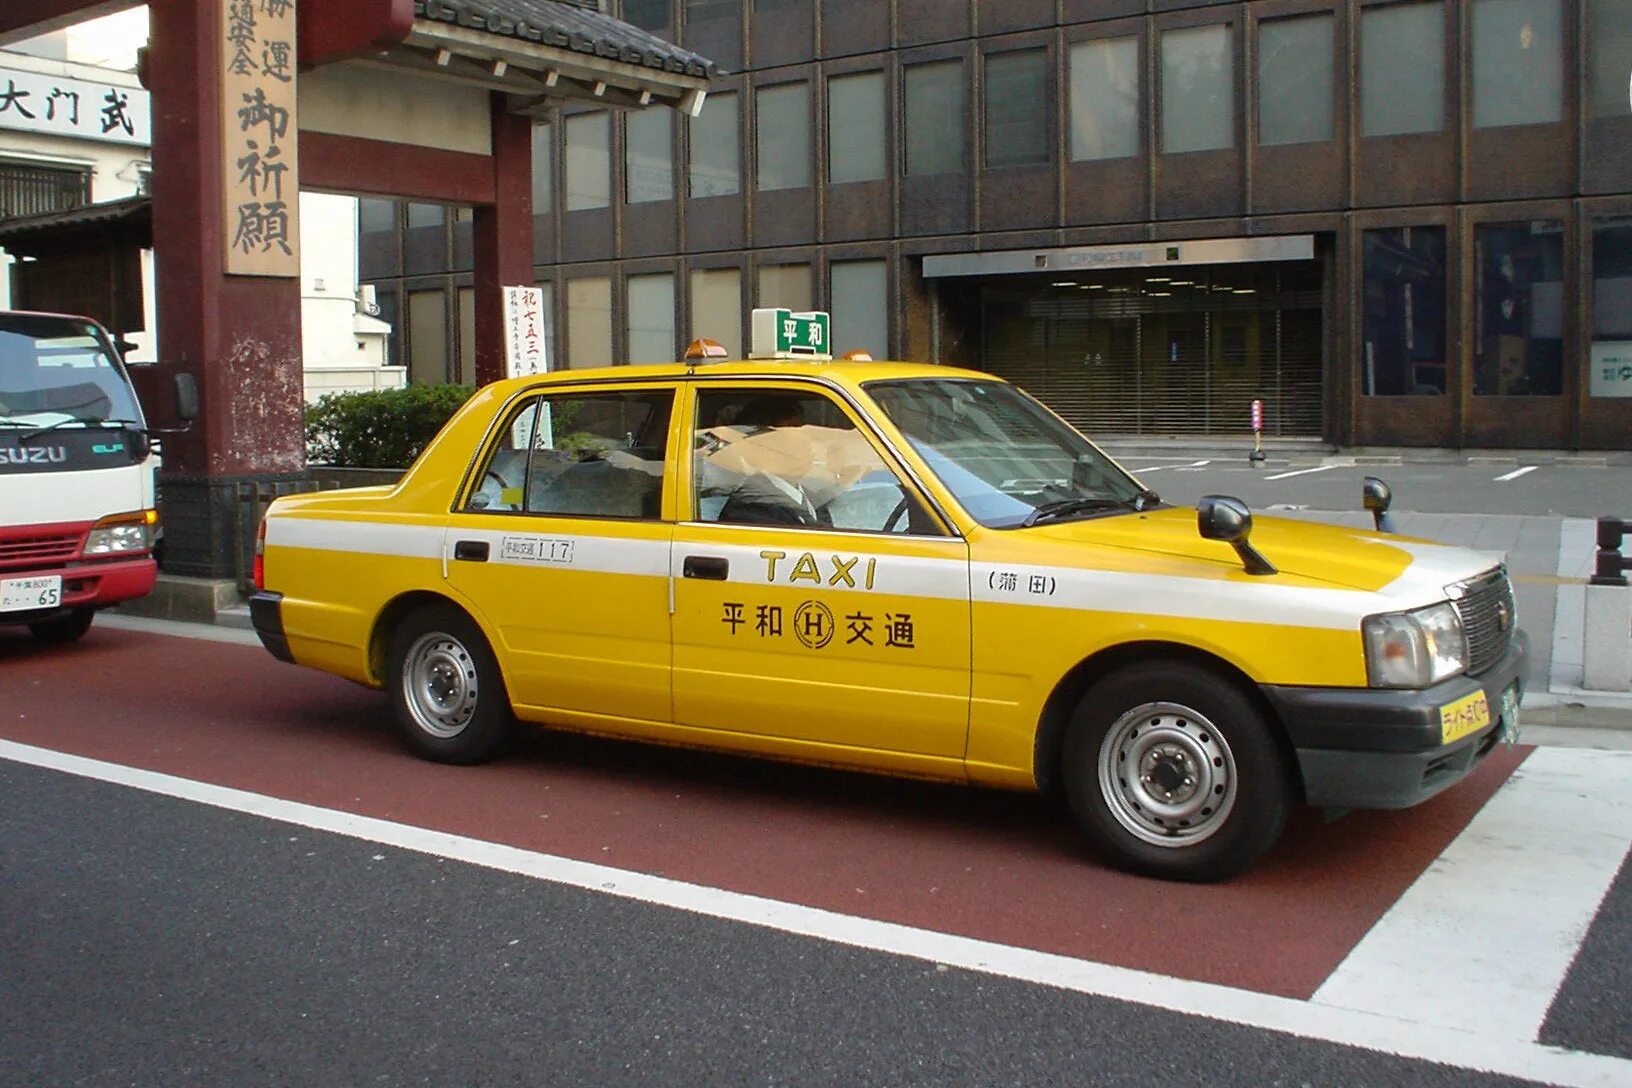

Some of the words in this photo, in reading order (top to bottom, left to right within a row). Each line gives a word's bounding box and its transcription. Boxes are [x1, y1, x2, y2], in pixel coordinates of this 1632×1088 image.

[232, 87, 293, 256] 御祈願
[783, 319, 822, 346] 平和
[539, 542, 569, 559] 117
[760, 550, 878, 590] TAXI
[39, 588, 57, 605] 65
[721, 602, 783, 638] 平和
[844, 610, 916, 649] 交通
